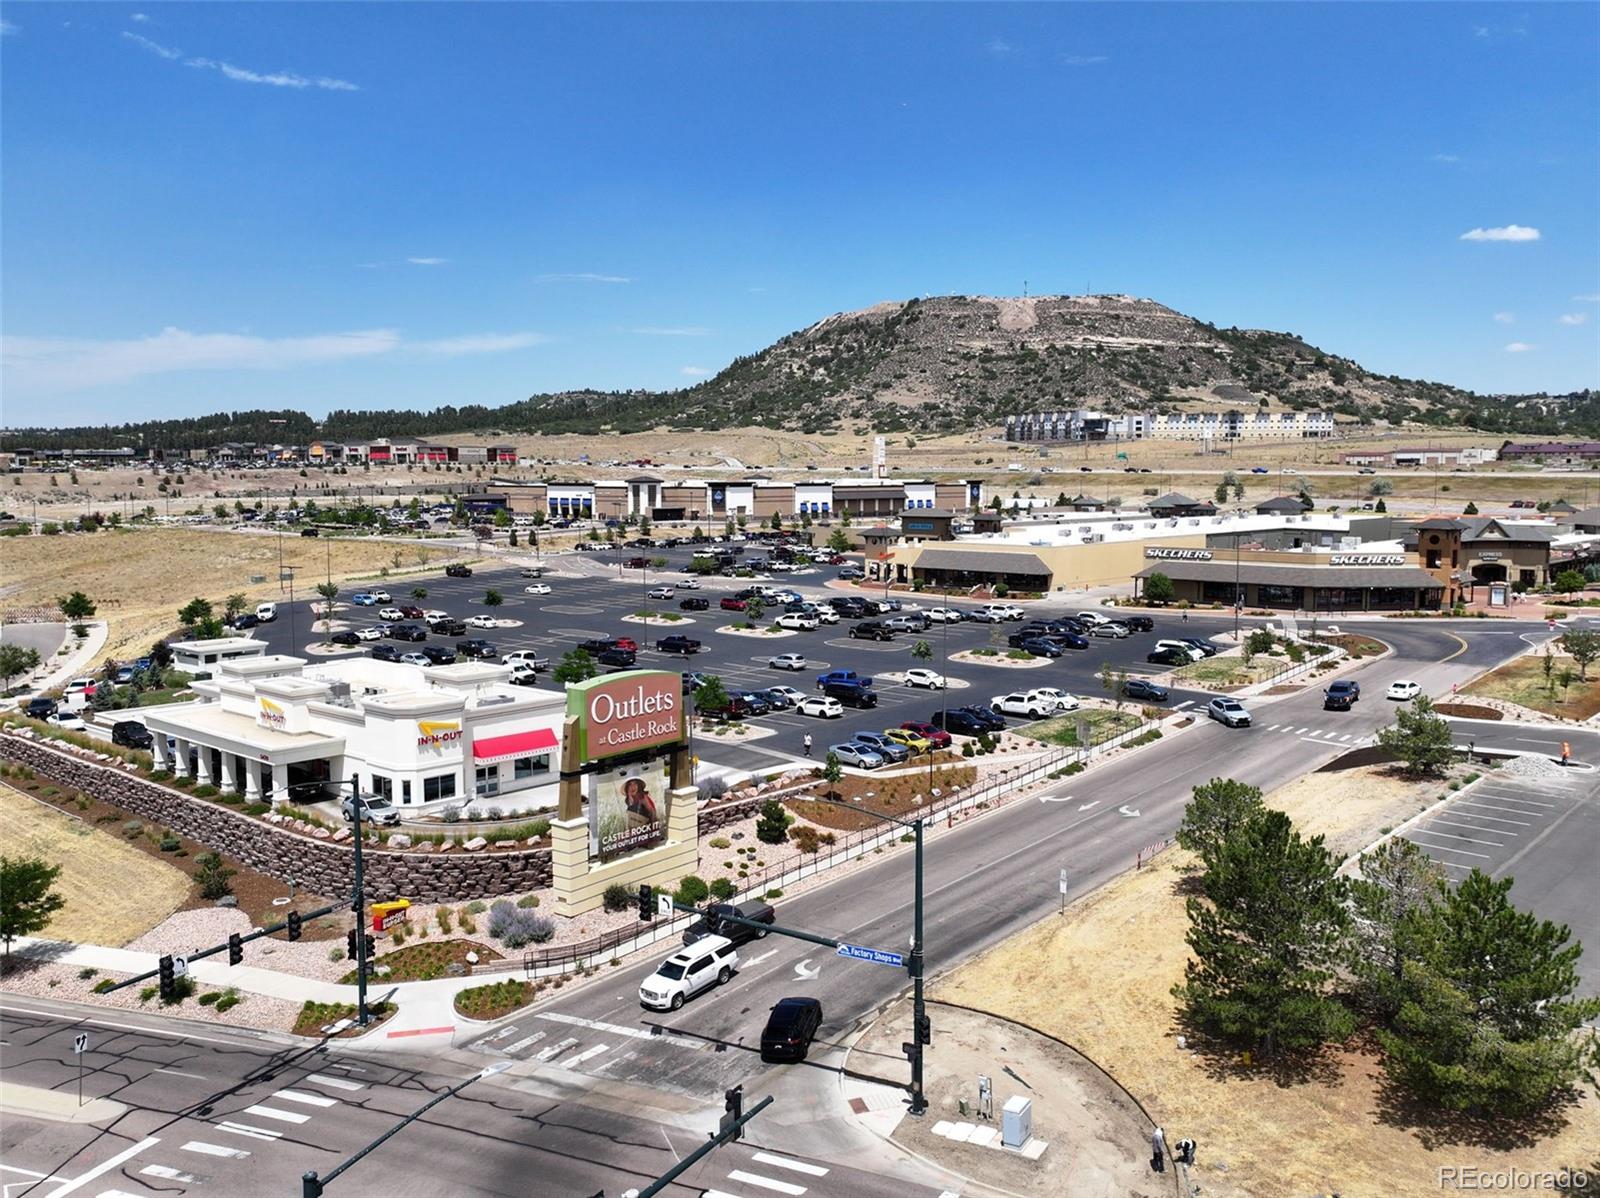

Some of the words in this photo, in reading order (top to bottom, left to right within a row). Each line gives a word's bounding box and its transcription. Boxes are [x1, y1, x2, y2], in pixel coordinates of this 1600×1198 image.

[1146, 548, 1213, 560] SKECHERS
[1330, 555, 1406, 565] SKECHERS
[591, 686, 674, 723] Outlets
[418, 730, 464, 746] IN-N-OUT
[599, 736, 606, 744] at
[608, 723, 646, 745] Castle
[648, 716, 677, 737] Rock
[602, 829, 630, 845] CASTLE
[631, 823, 652, 837] ROCK
[602, 843, 617, 852] YOUR
[617, 836, 638, 848] OUTLET
[638, 833, 649, 843] FOR
[850, 946, 873, 961] Factory
[873, 951, 892, 963] Shops
